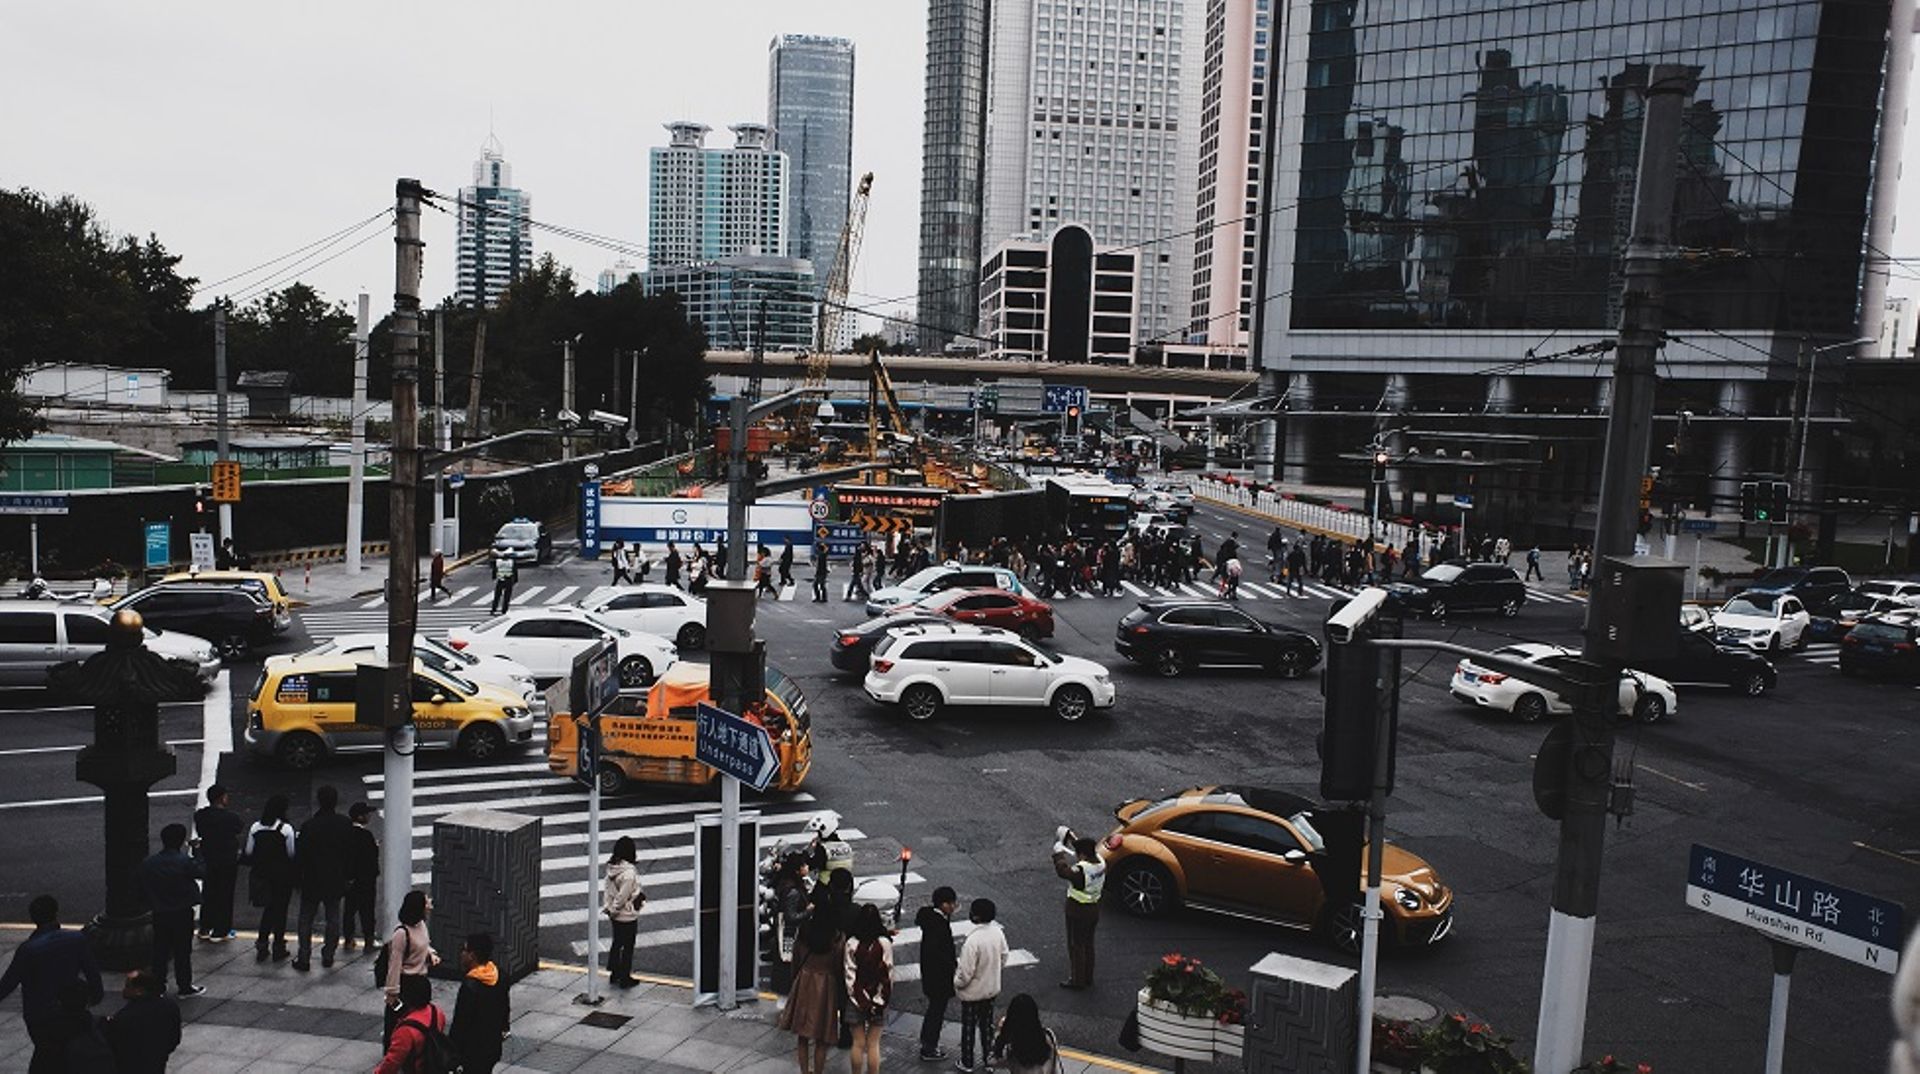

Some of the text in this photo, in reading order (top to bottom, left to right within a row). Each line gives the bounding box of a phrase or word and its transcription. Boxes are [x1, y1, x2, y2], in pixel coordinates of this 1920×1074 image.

[699, 713, 760, 761] 行人地下通道
[699, 739, 754, 776] Underpass
[1738, 867, 1842, 926] 华山路
[1868, 907, 1885, 926] 北
[1701, 893, 1880, 964] S Huashan Rd. N
